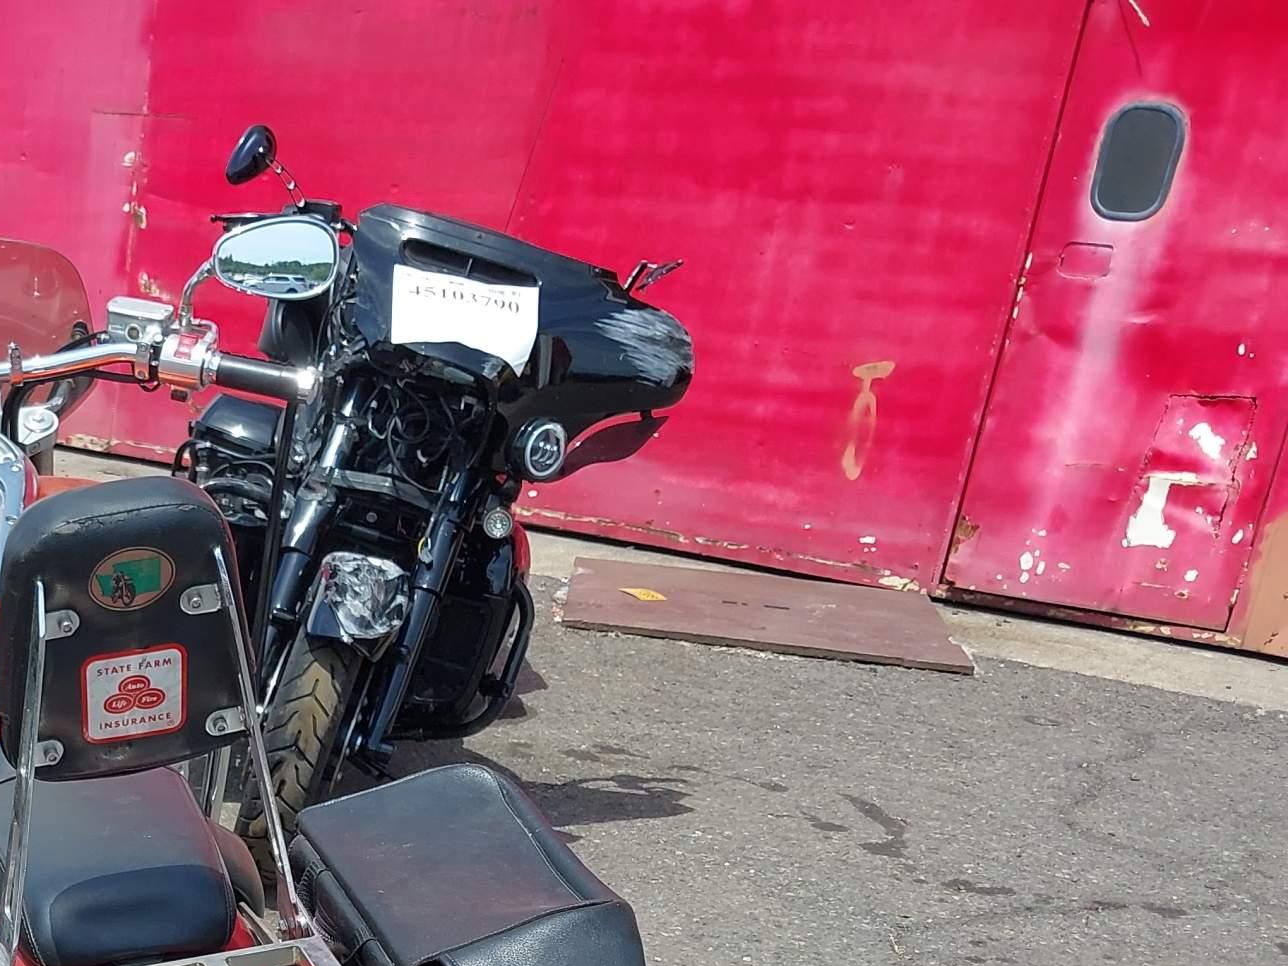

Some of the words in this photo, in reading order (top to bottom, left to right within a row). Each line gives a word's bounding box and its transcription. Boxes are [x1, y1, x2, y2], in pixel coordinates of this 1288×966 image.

[96, 664, 132, 677] STATE
[138, 657, 173, 671] FARM
[141, 695, 158, 703] Fire
[99, 712, 172, 730] INSURANCE
